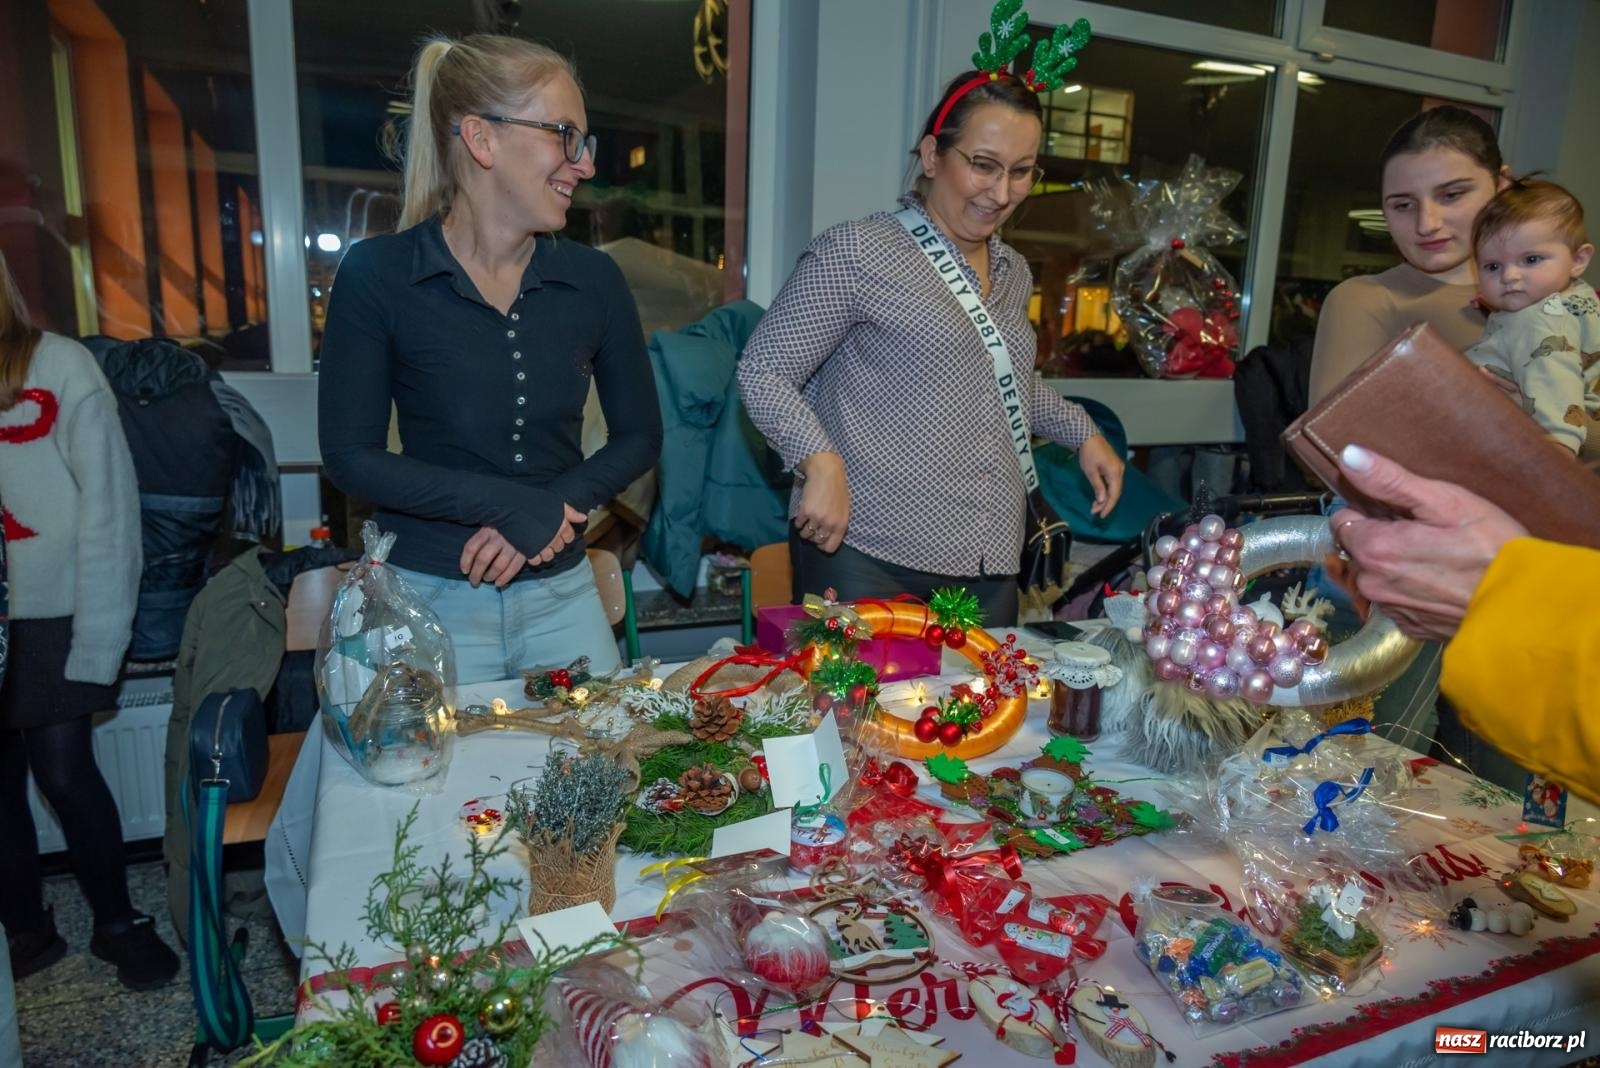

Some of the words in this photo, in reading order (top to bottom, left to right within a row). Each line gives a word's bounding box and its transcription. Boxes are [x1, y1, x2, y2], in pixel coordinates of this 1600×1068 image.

[911, 224, 973, 296] DEAUTY
[968, 304, 1002, 349] 1987
[998, 373, 1029, 456] DEAUTY
